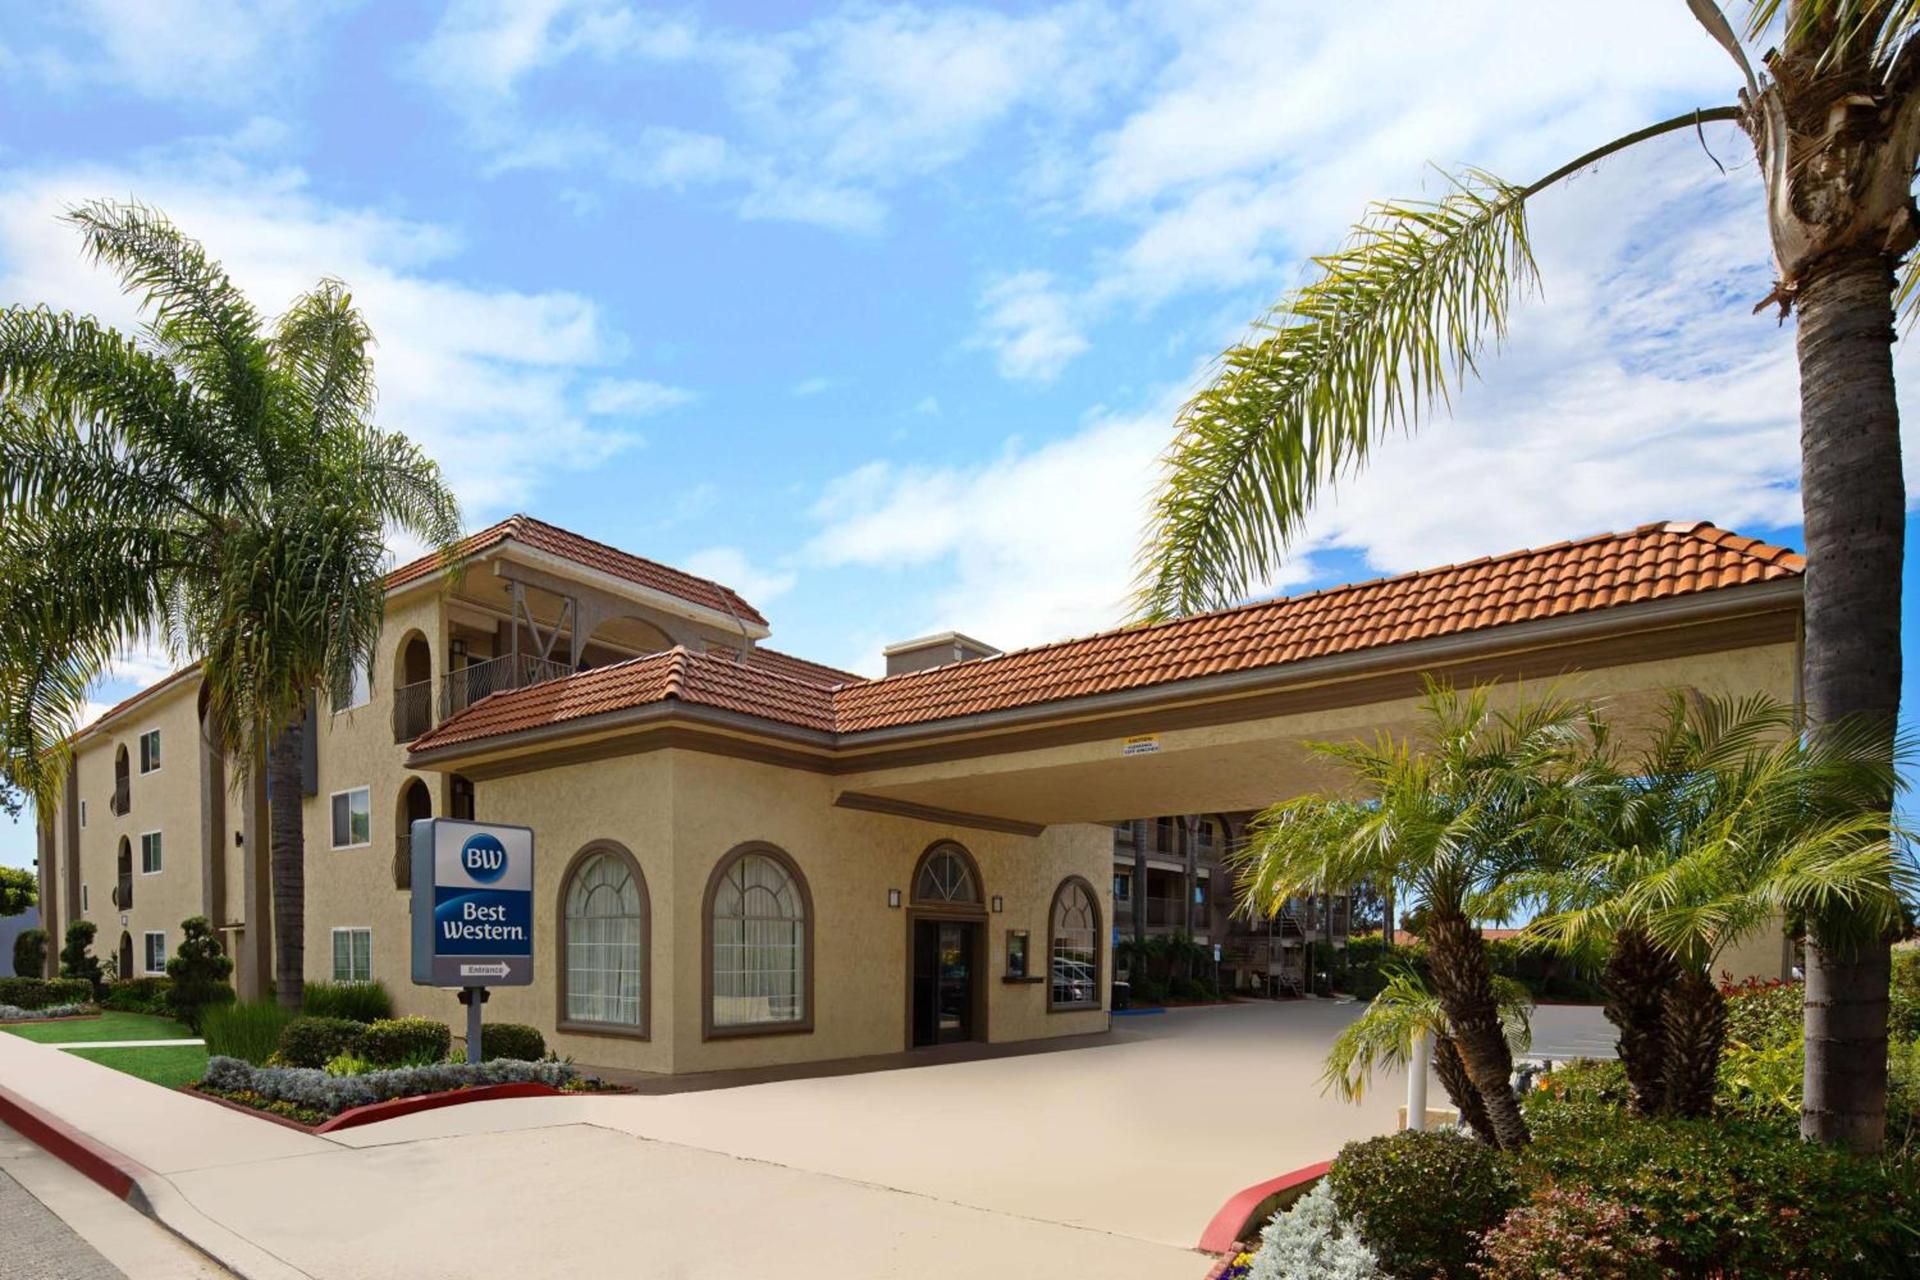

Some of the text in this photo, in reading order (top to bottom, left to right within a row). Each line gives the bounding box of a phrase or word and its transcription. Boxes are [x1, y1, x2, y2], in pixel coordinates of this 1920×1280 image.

[467, 848, 502, 869] BW
[464, 902, 506, 921] Best
[468, 965, 504, 975] Entrance
